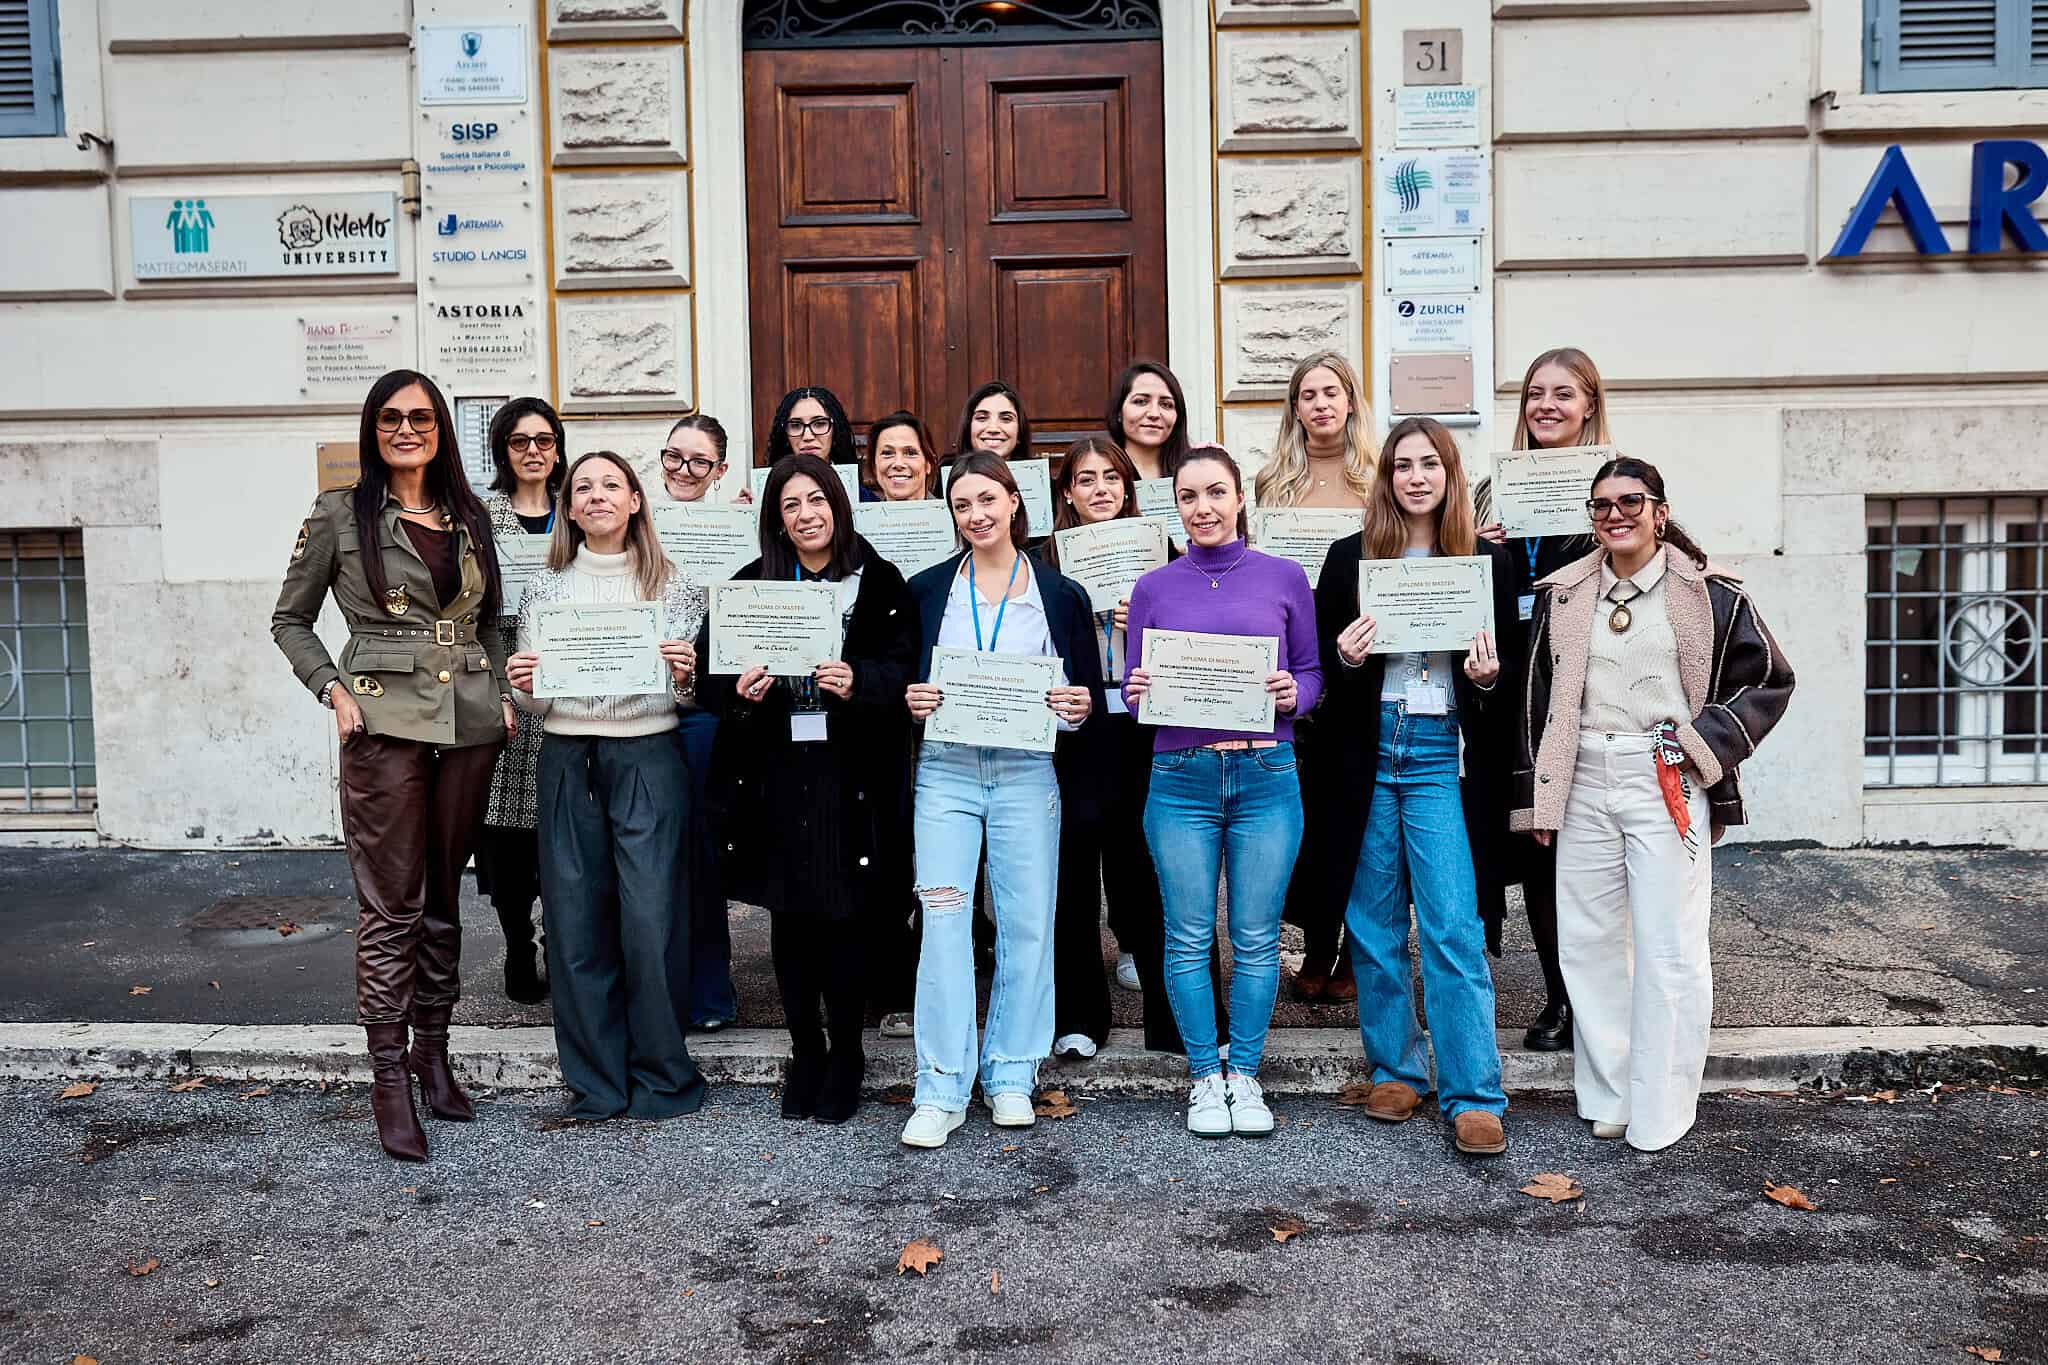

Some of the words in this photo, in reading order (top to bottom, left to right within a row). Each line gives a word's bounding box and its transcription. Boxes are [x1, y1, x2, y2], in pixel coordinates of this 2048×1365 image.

[1416, 41, 1448, 72] 31
[1426, 90, 1475, 100] AFFITTASI
[452, 123, 498, 140] SISP
[472, 150, 501, 159] Italiana
[484, 162, 525, 171] Psicologia
[459, 219, 503, 229] ARTEMISIA
[283, 250, 388, 265] UNIVERSITY
[432, 251, 476, 262] STUDIO
[481, 249, 526, 261] LANCISI
[137, 260, 247, 274] MATTEOMASERATI
[437, 304, 524, 318] ASTORIA
[1419, 304, 1464, 315] ZURICH
[1180, 655, 1207, 663] DIPLOMA
